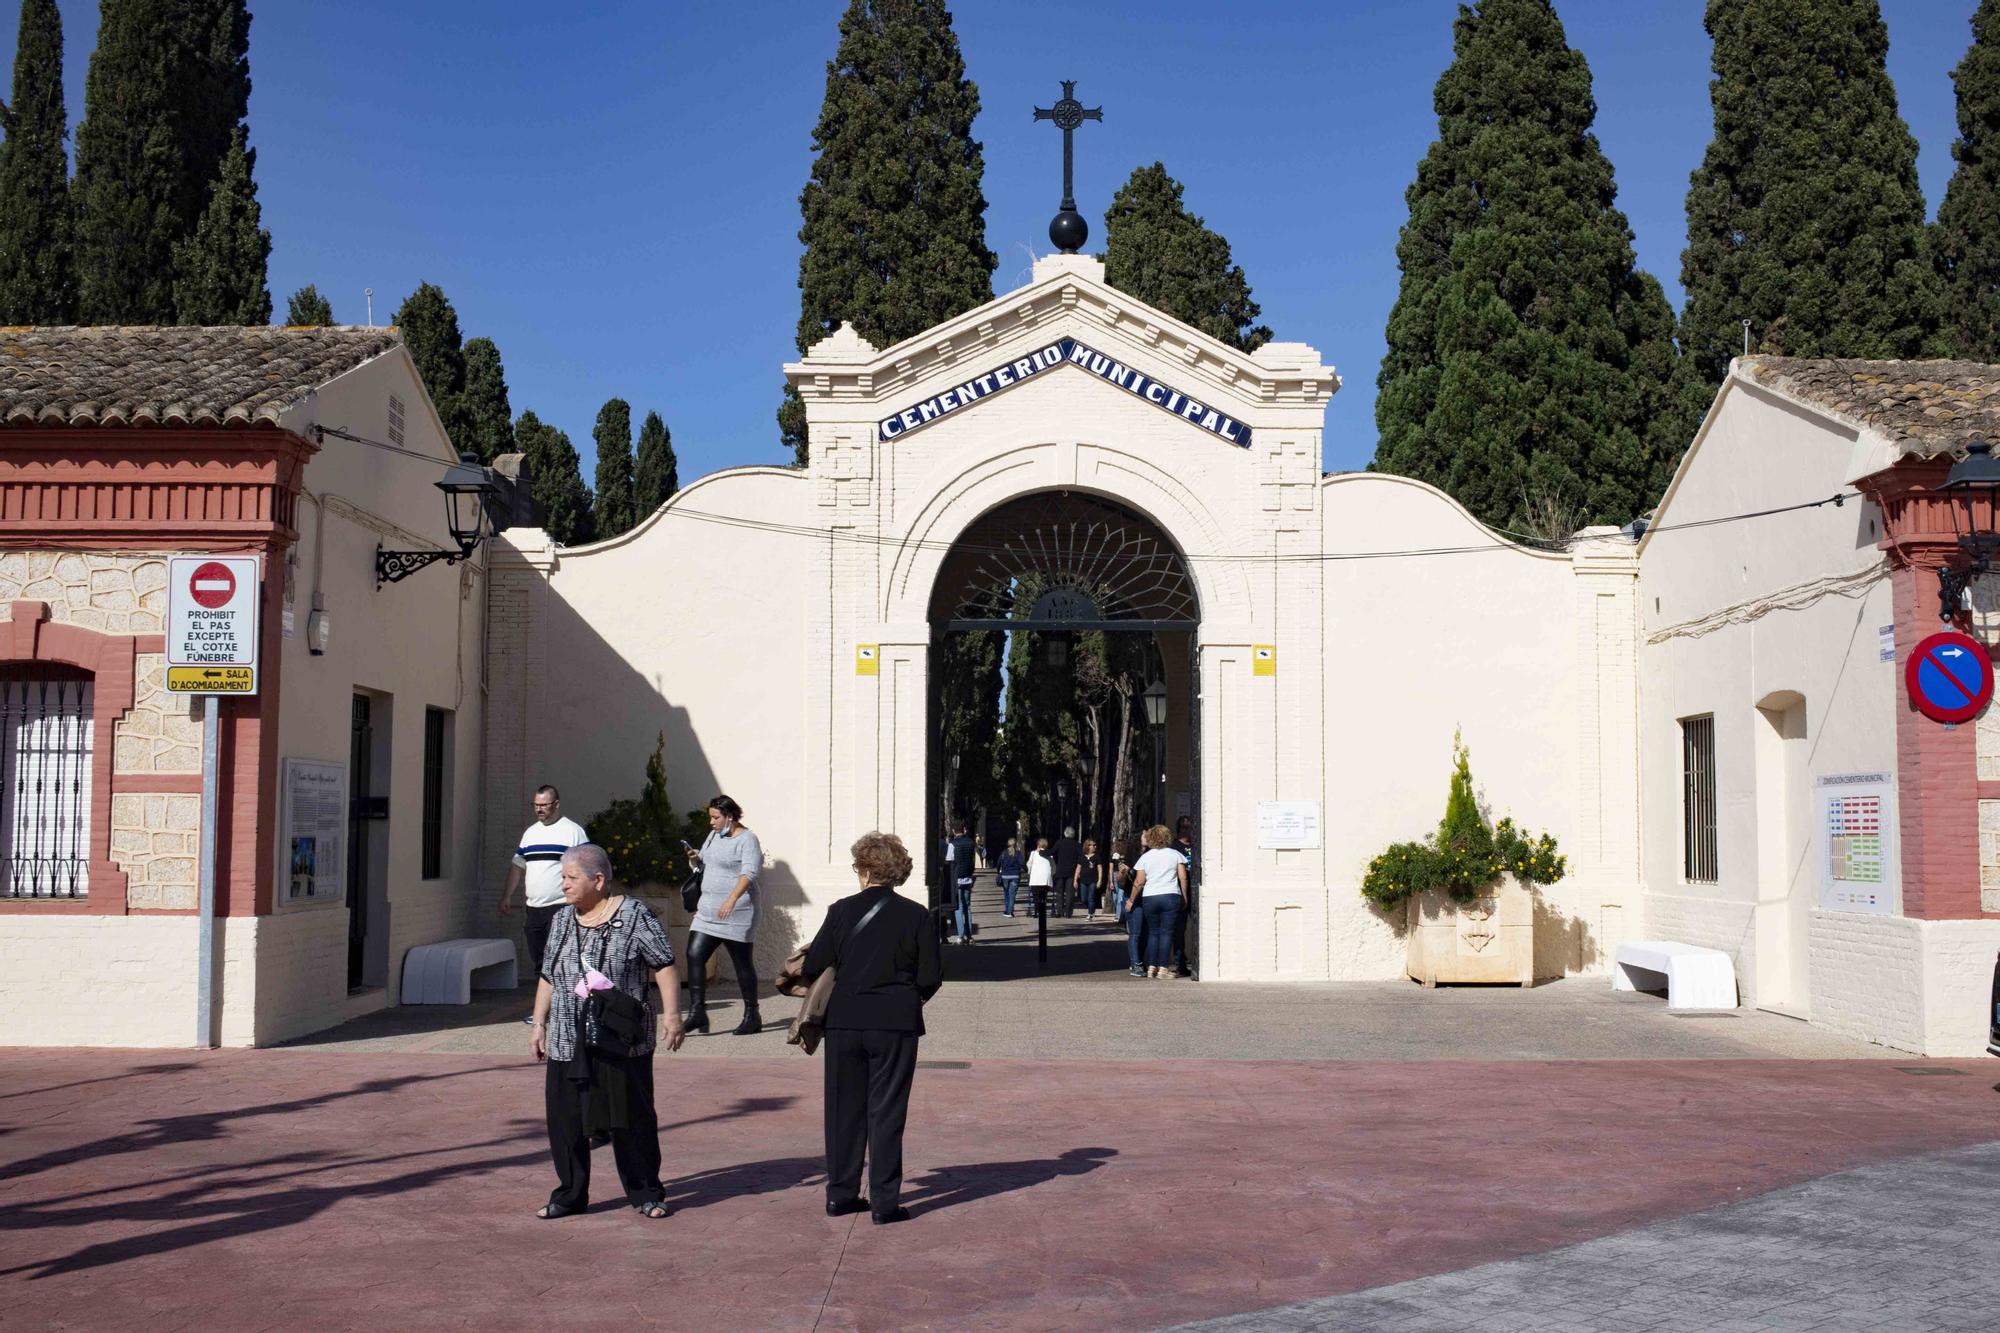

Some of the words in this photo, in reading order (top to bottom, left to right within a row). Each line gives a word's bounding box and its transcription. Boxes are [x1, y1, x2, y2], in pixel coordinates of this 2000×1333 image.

[881, 344, 1063, 441] CEMENTERIO
[1069, 343, 1238, 441] MUNICIPAL
[187, 610, 236, 619] PROHIBIT
[192, 621, 204, 630] EL
[210, 621, 231, 630] PAS
[187, 632, 235, 641] EXCEPTE
[184, 642, 196, 651] EL
[202, 642, 238, 651] COTXE
[186, 651, 235, 662] FÚNEBRE
[226, 670, 249, 678] SALA
[171, 681, 249, 689] D'ACOMIADAMENT
